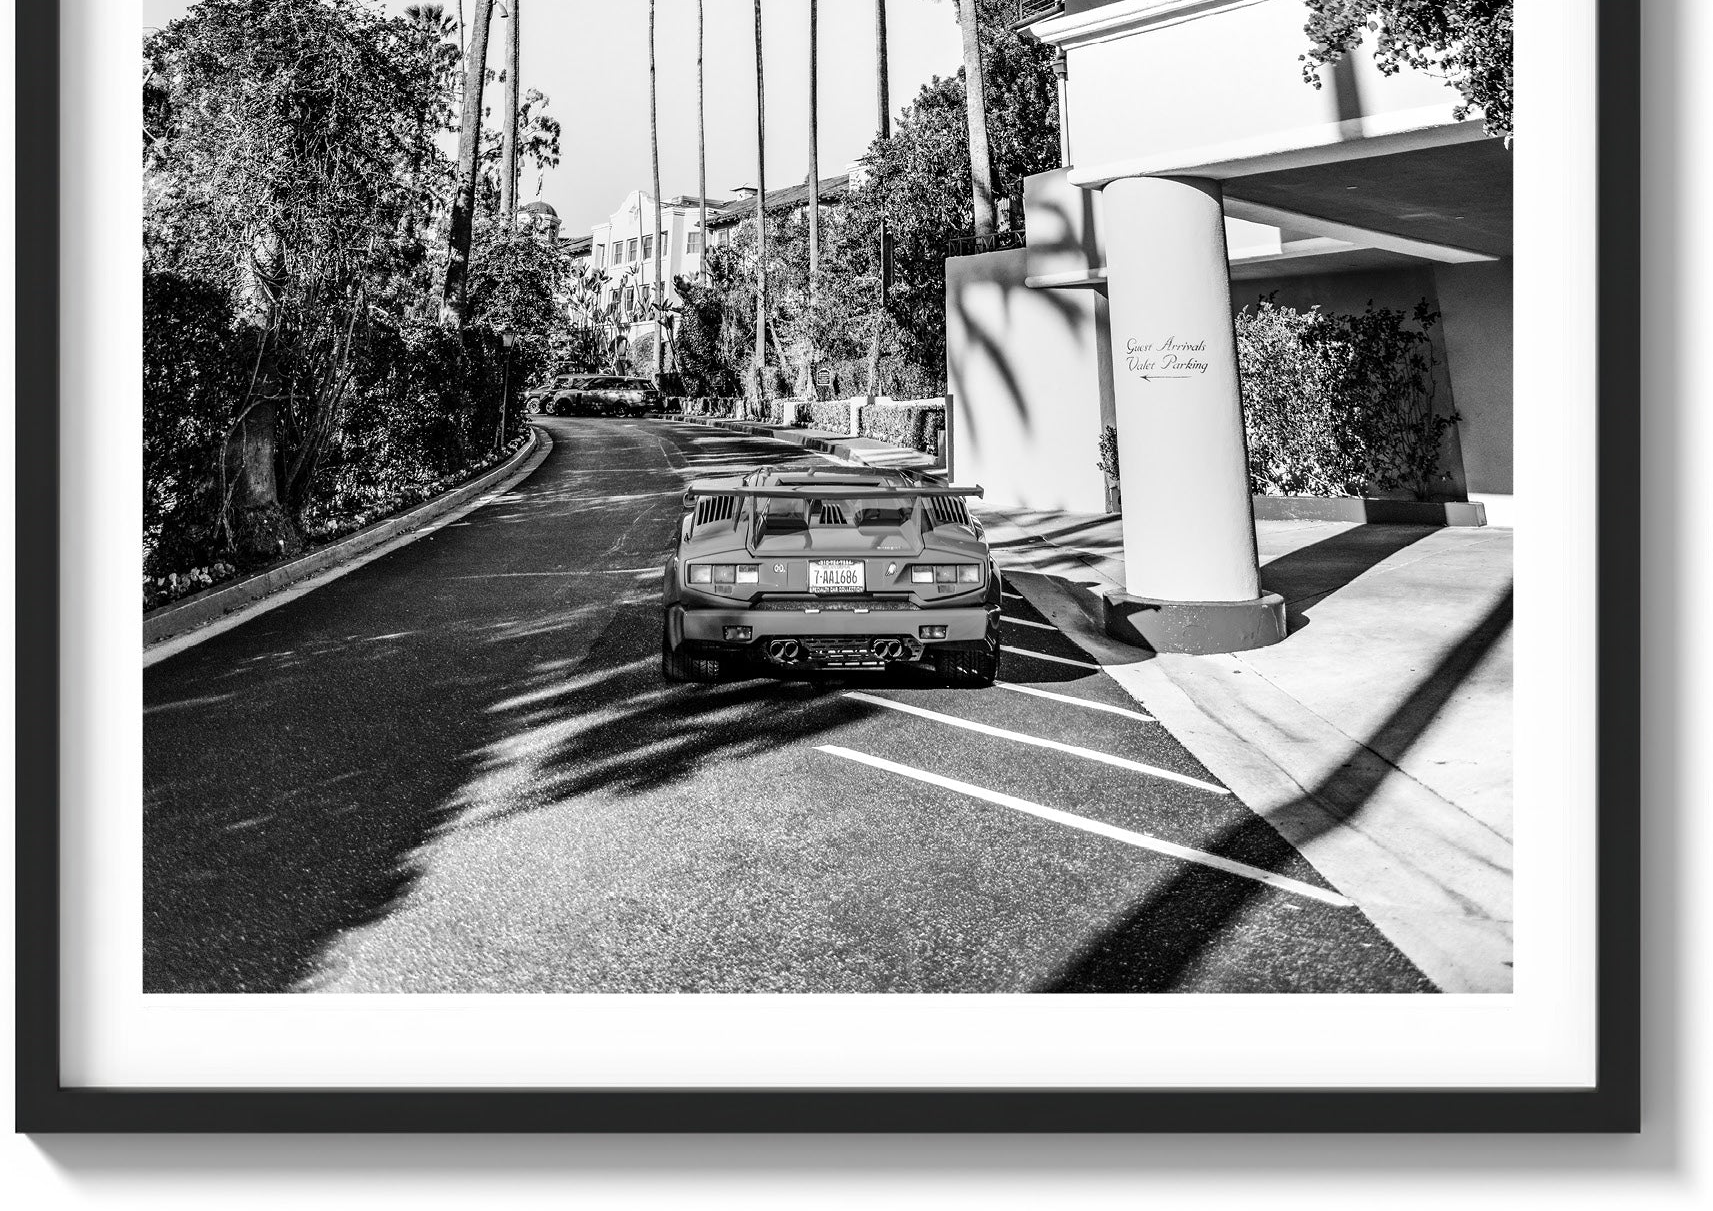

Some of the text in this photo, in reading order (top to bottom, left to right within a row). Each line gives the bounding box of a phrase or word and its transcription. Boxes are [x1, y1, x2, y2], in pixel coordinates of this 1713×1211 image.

[1126, 336, 1206, 354] Guest Arrivals
[1126, 354, 1208, 373] Valet Parking
